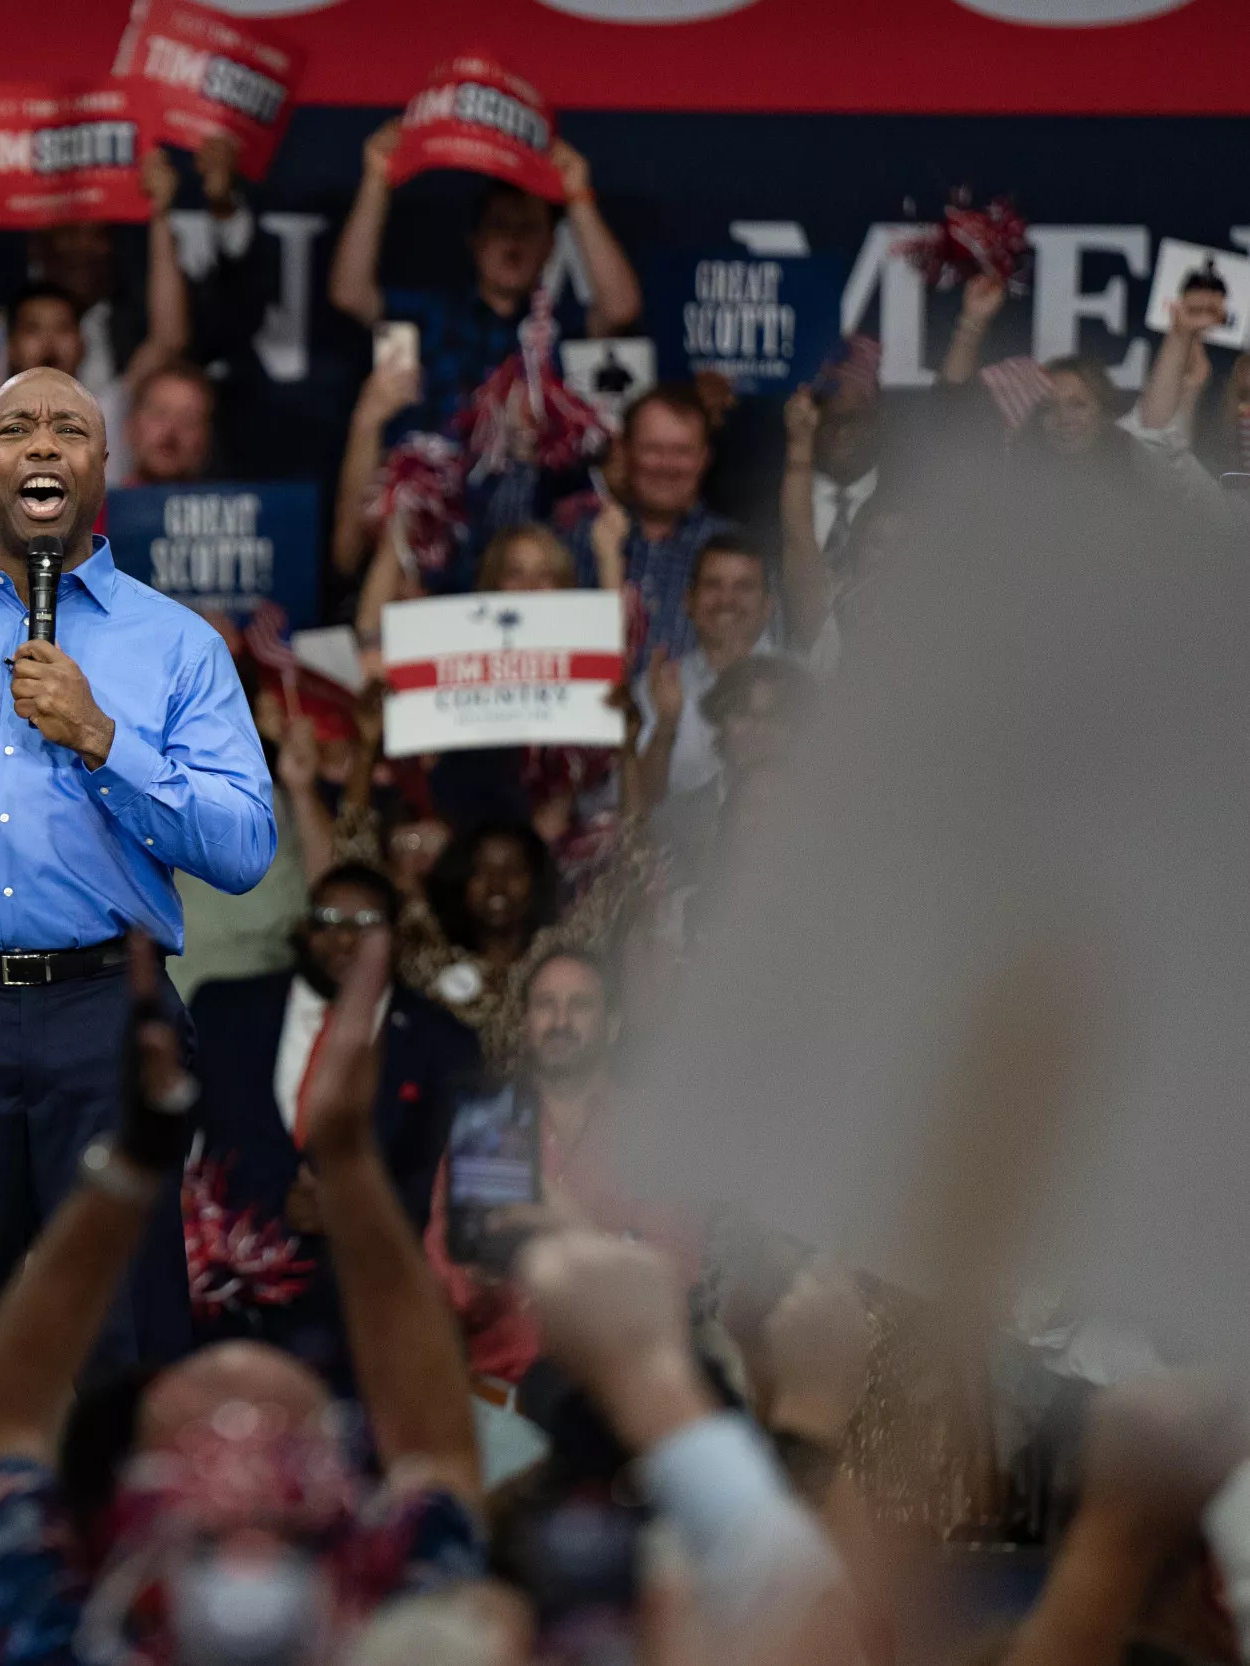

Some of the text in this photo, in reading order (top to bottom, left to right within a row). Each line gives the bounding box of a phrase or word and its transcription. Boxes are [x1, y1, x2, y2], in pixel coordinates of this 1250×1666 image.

[31, 120, 139, 175] SCOTT
[694, 259, 783, 302] GREAT
[682, 300, 796, 358] SCOTT!
